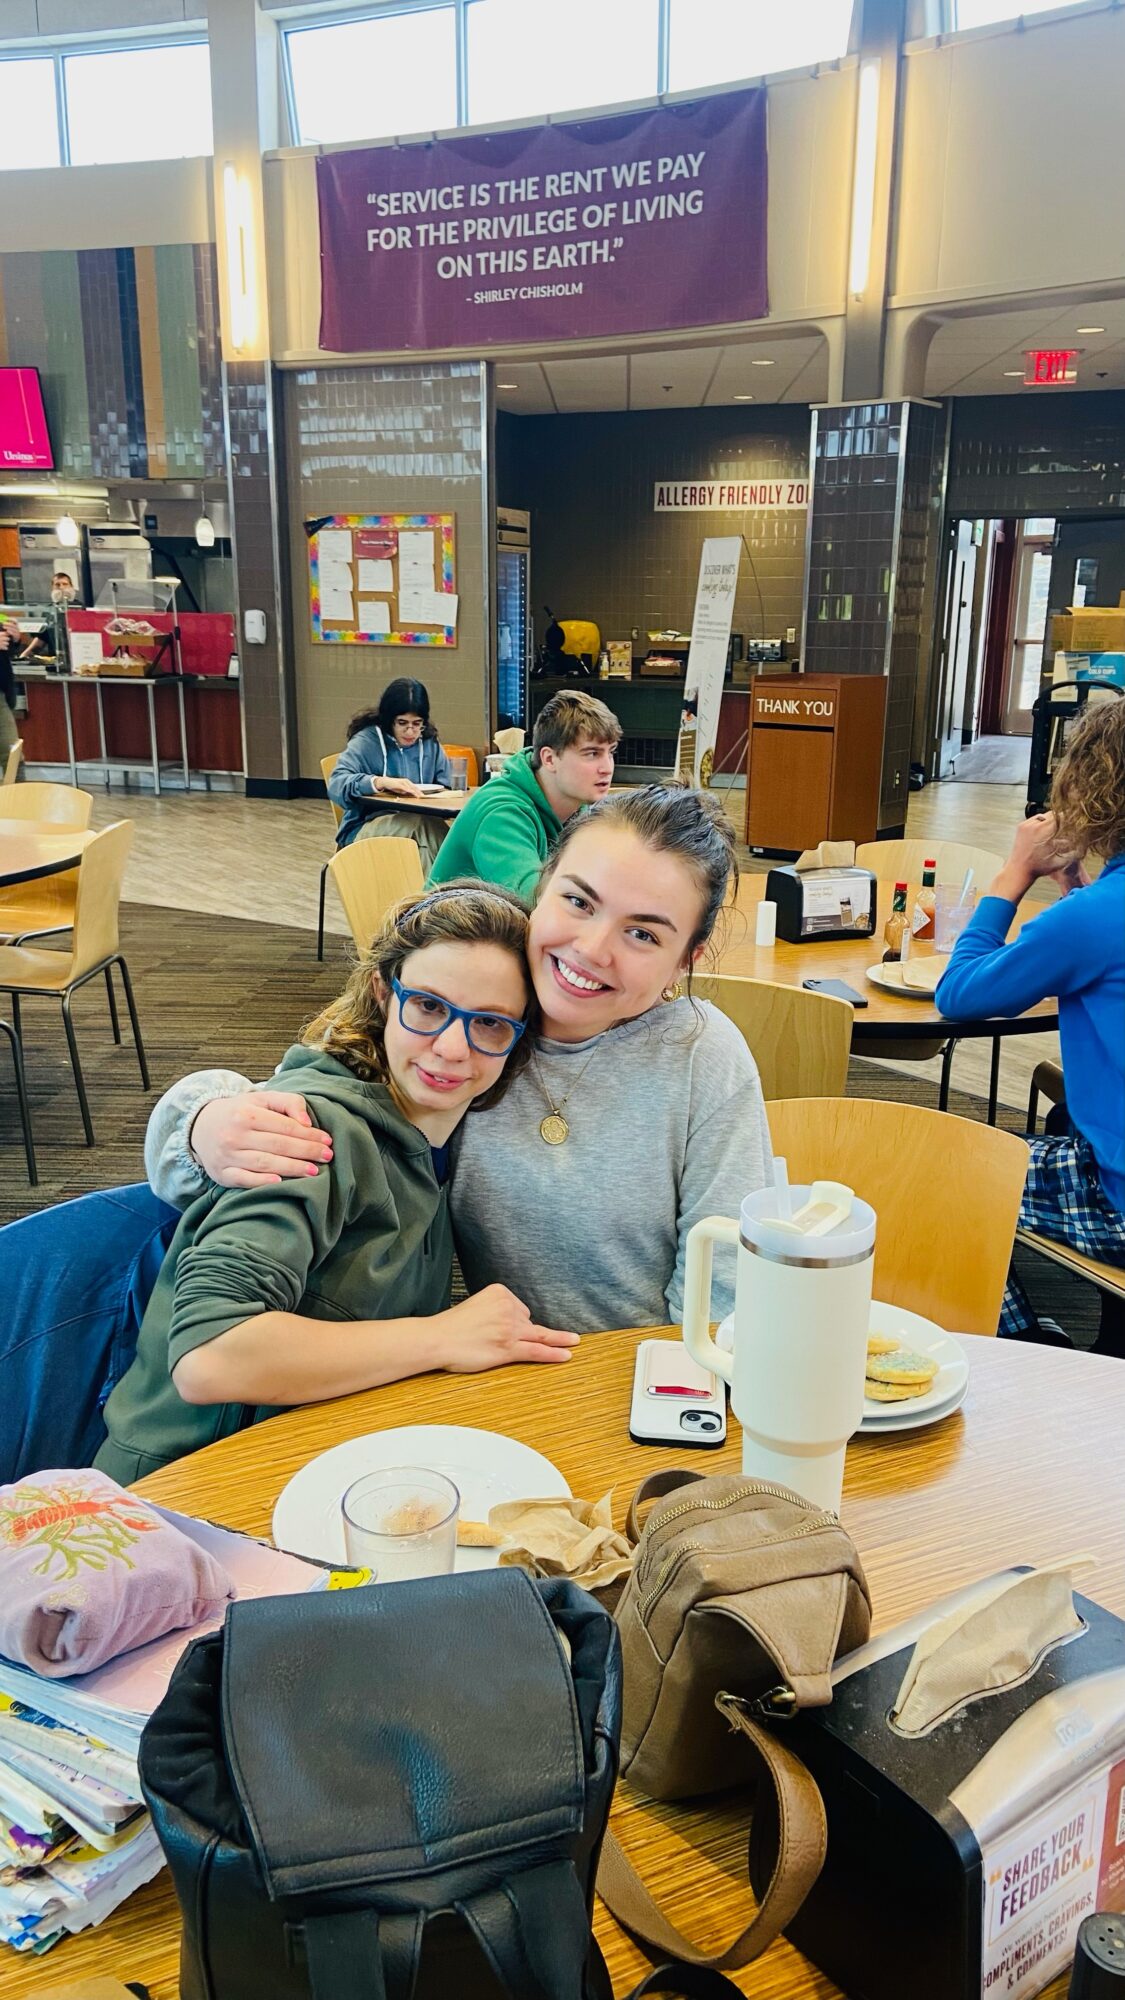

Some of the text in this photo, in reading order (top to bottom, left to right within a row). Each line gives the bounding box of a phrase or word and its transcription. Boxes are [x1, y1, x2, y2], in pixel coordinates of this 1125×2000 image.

[367, 152, 706, 217] “SERVICE IS THE RENT WE PAY
[367, 190, 704, 252] FOR THE PRIVILEGE OF LIVING
[437, 237, 624, 279] ON THIS EARTH.”
[473, 287, 518, 304] SHIRLEY
[519, 282, 583, 300] CHISHOLM
[1034, 353, 1070, 382] EXIT
[657, 486, 715, 507] ALLERGY
[719, 484, 783, 505] FRIENDLY
[756, 698, 834, 716] THANK YOU
[1003, 1839, 1047, 1892] SHARE
[1051, 1812, 1086, 1857] YOUR
[1000, 1839, 1082, 1926] FEEDBACK
[1007, 1927, 1069, 1990] & COMMENTS!
